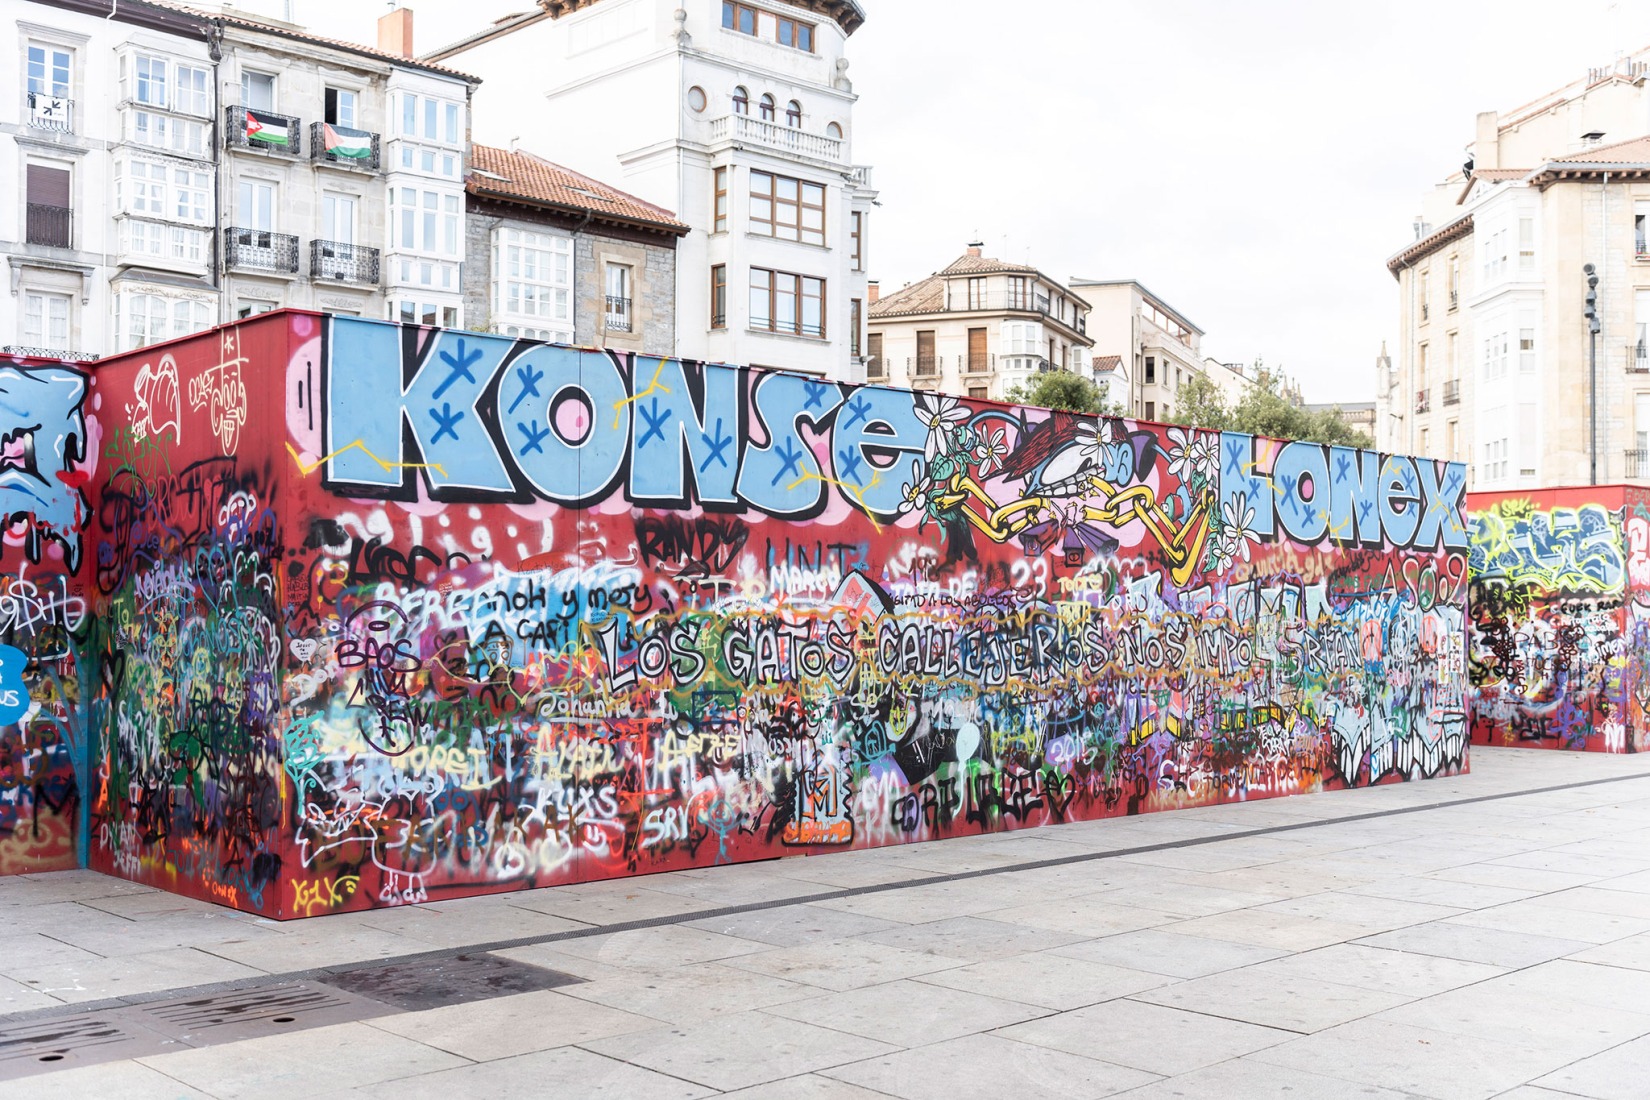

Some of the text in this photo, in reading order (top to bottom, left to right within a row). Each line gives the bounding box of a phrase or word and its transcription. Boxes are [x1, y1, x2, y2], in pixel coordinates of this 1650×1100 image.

[634, 516, 750, 574] RANDY
[599, 614, 706, 691] LOS
[721, 618, 857, 687] GATOS
[879, 621, 1109, 687] CALLEJEROS
[1121, 622, 1189, 670] NOS
